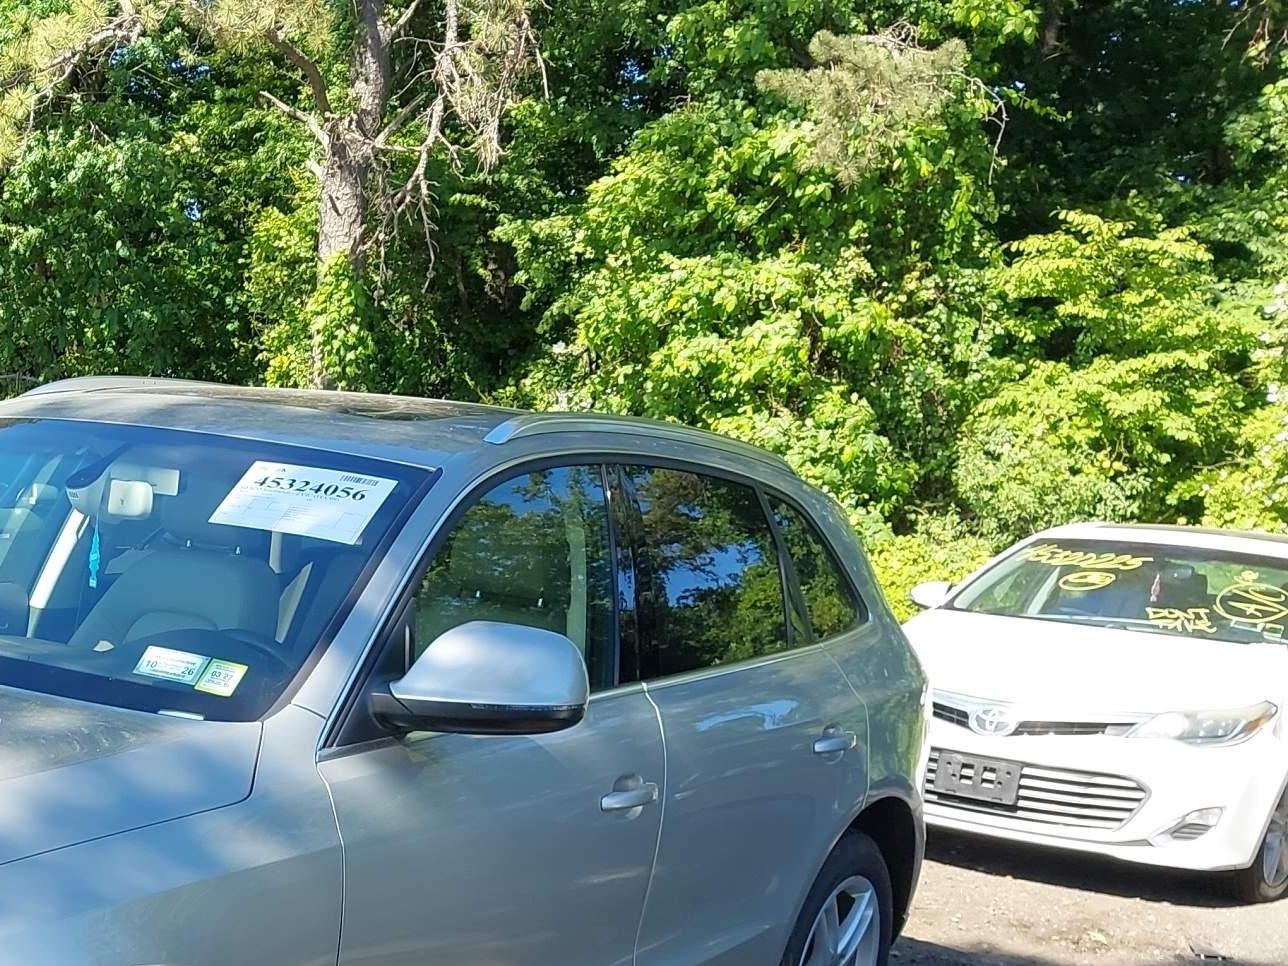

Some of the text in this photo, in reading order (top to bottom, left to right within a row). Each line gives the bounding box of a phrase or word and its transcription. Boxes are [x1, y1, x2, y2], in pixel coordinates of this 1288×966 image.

[253, 475, 369, 502] 45324056
[145, 659, 158, 669] 10
[181, 666, 195, 676] 26
